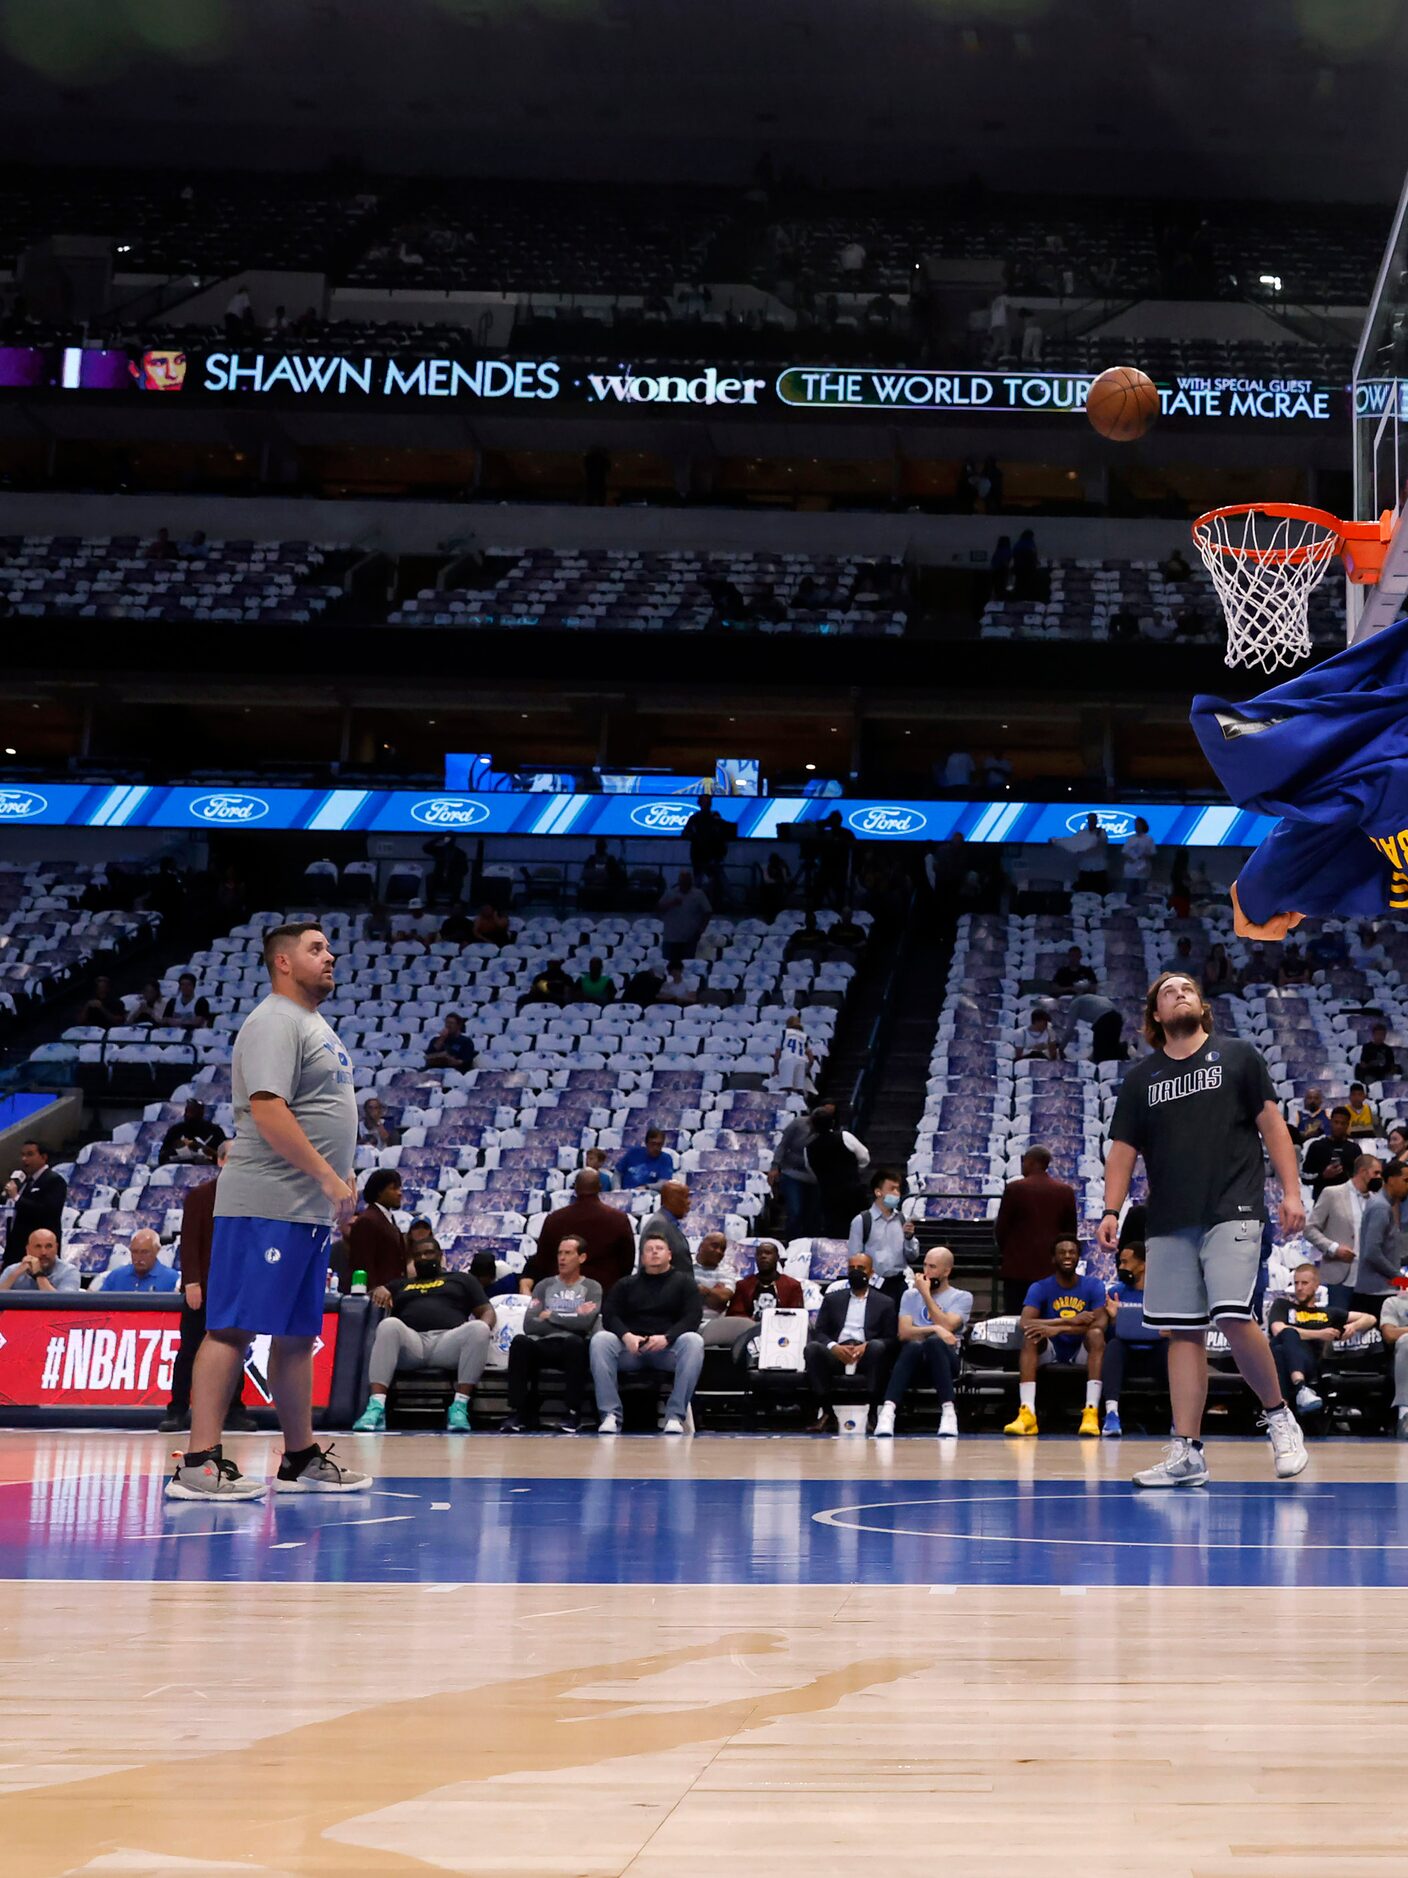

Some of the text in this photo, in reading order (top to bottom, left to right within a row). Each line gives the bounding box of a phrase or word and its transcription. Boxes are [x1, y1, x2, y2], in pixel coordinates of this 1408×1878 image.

[203, 351, 1090, 408] SHAWN MENDES wonder THE WORLD TOUR
[1177, 377, 1313, 393] WITH SPECIAL GUEST
[1156, 390, 1330, 419] TATE MCRAE
[202, 794, 254, 820] Ford
[424, 798, 476, 824] Ford
[644, 805, 695, 826] Ford
[862, 809, 912, 832] Ford
[1148, 1065, 1223, 1107] DALLAS
[40, 1328, 182, 1391] #NBA75
